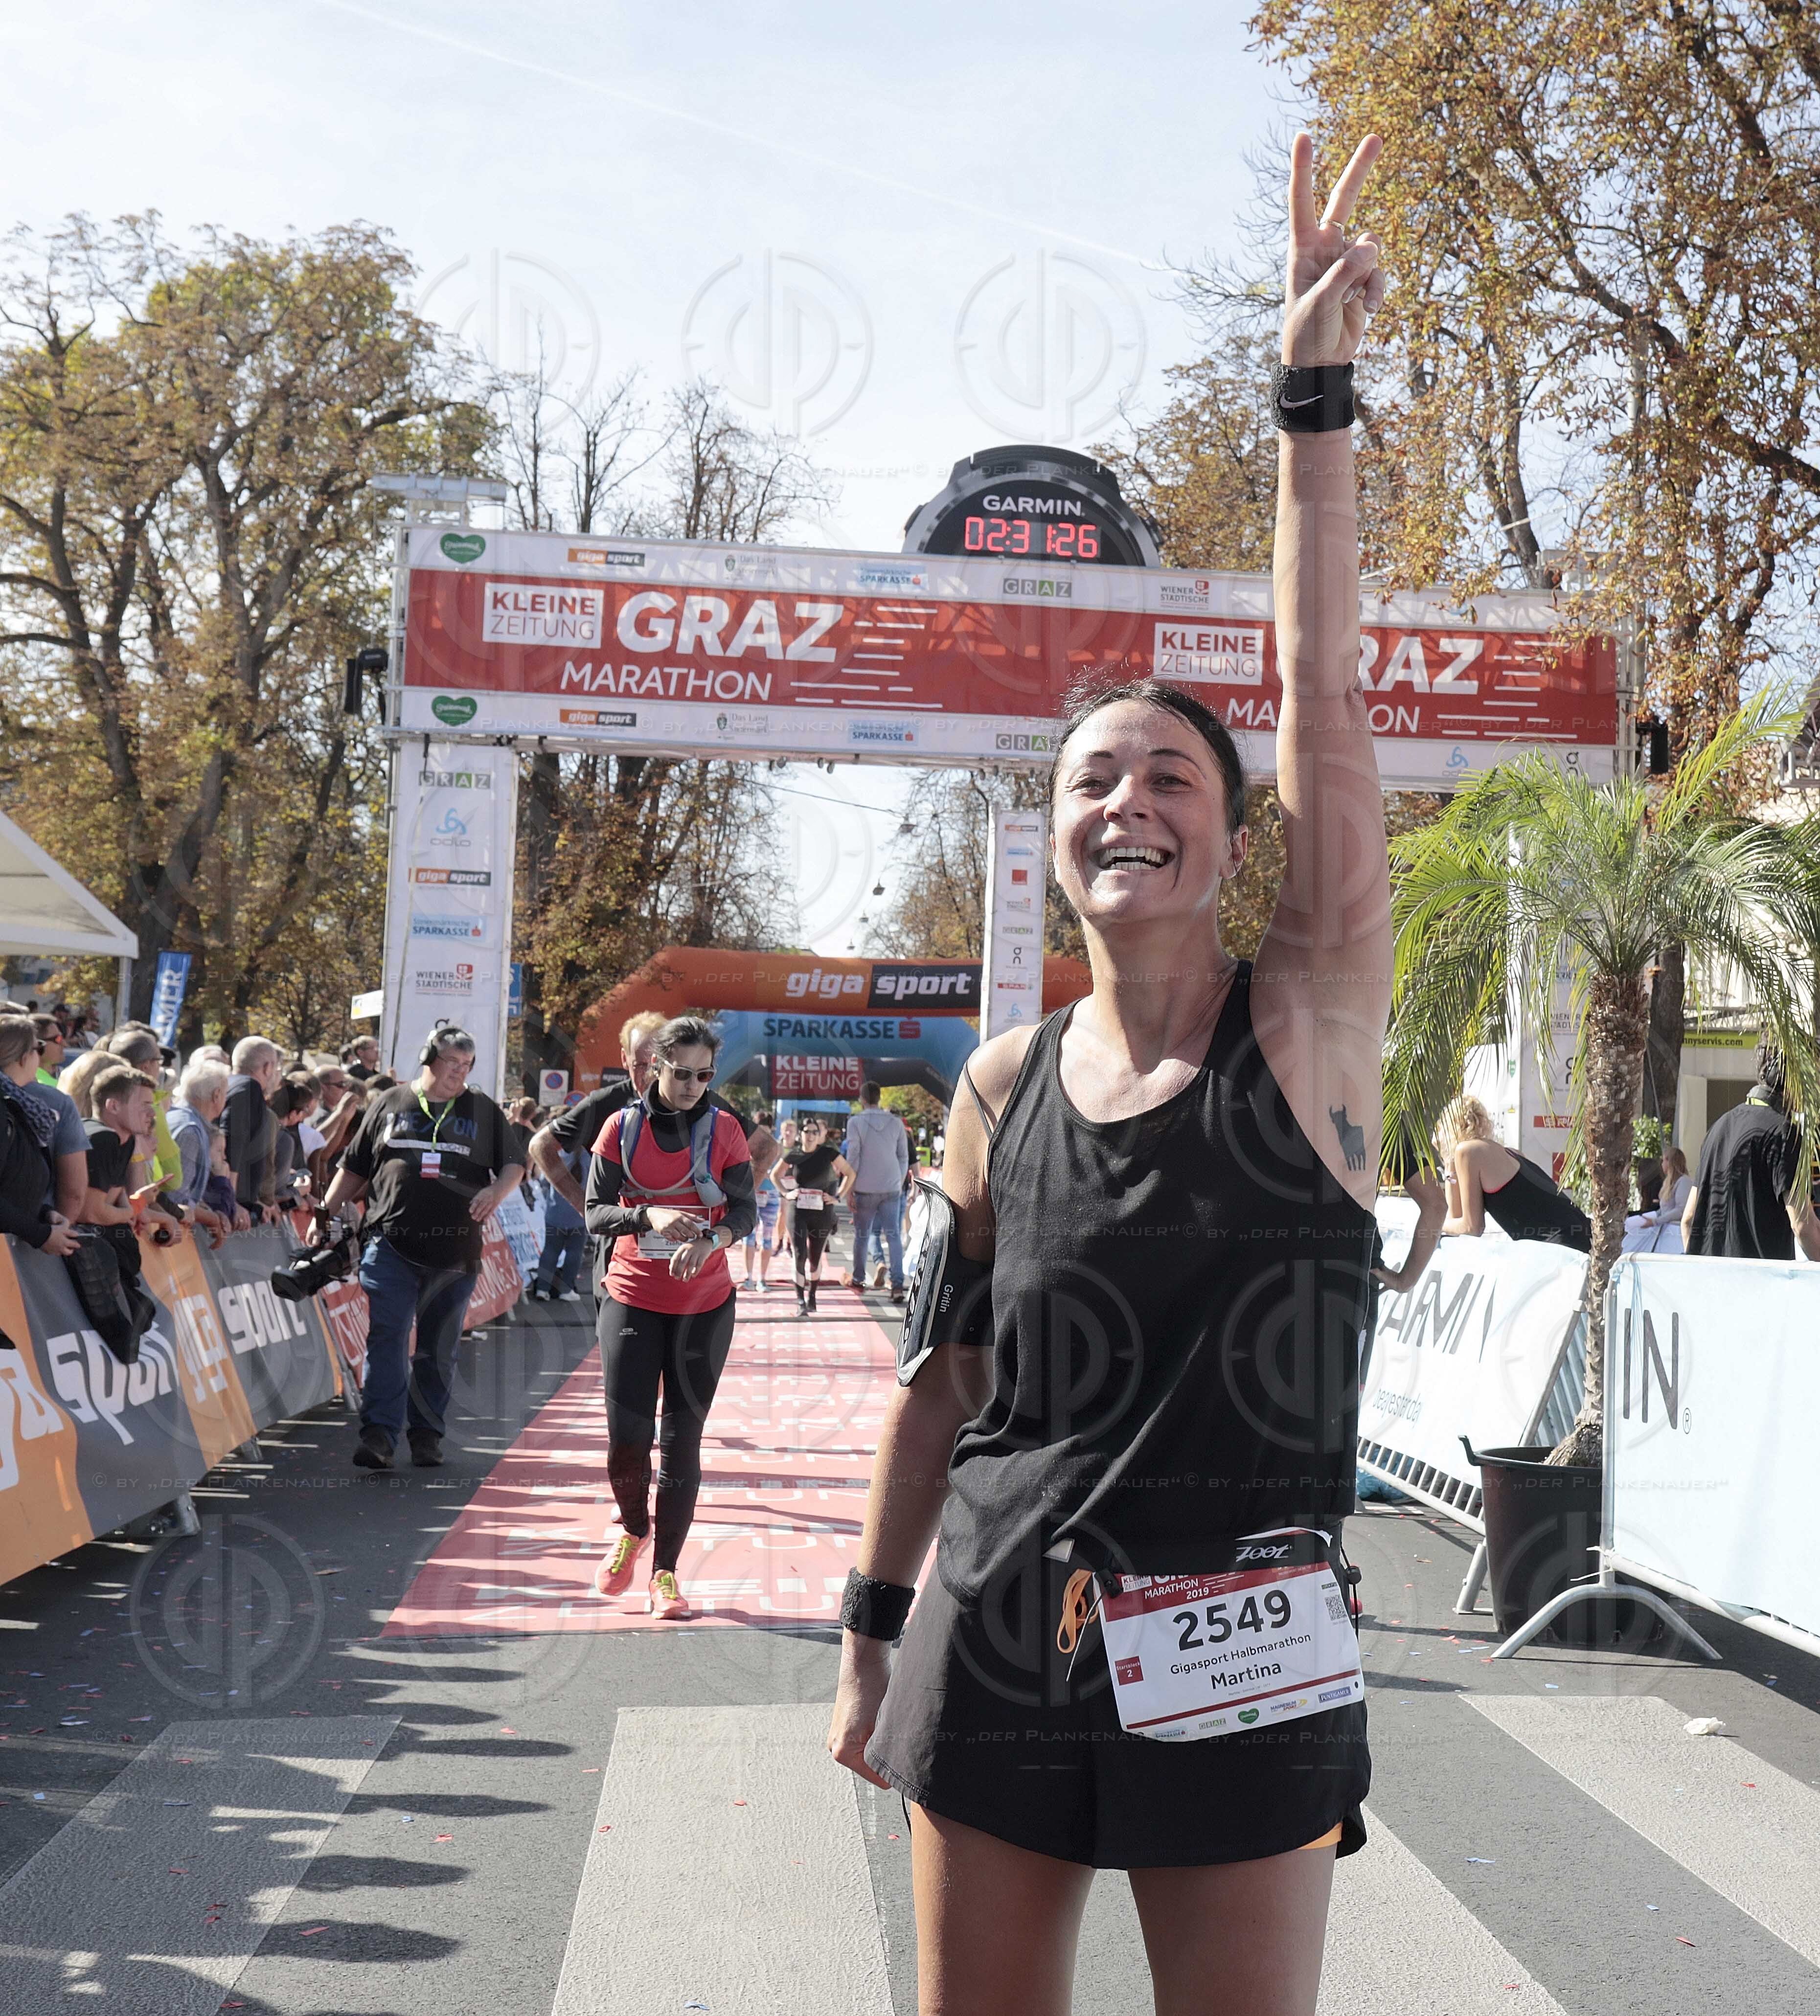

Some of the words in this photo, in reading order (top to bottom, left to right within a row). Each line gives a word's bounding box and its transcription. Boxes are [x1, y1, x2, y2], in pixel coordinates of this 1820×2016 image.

[983, 495, 1082, 516] GARMIN
[860, 575, 911, 585] SPARKASSE
[1004, 578, 1071, 597] GRAZ
[1160, 586, 1194, 595] WIENER
[491, 591, 596, 617] KLEINE
[491, 614, 595, 640] ZEITUNG
[616, 591, 843, 663] GRAZ
[1161, 631, 1257, 655] KLEINE
[1160, 653, 1256, 677] ZEITUNG
[1276, 634, 1484, 696] RAZ
[560, 661, 772, 702] MARATHON
[568, 711, 595, 724] giga
[598, 714, 632, 726] sport
[1226, 698, 1420, 733] MAON
[853, 731, 904, 742] SPARKASSE
[997, 734, 1047, 751] GRA
[420, 772, 488, 789] GRAZ
[418, 870, 447, 882] giga
[450, 873, 487, 884] sport
[412, 926, 470, 937] SPARKASSE
[416, 970, 454, 979] WIENER
[785, 968, 864, 999] giga
[875, 971, 972, 1000] sport
[763, 1018, 895, 1040] SPARKASSE
[775, 1055, 859, 1071] KLEINE
[775, 1072, 860, 1091] ZEITUNG
[939, 1284, 954, 1313] Gritin
[1124, 1579, 1150, 1590] ZEITUNG
[1145, 1578, 1198, 1599] MARATHON
[1186, 1586, 1209, 1600] 2019
[1173, 1589, 1291, 1651] 2549
[1170, 1653, 1228, 1676] Gigasport
[1230, 1633, 1311, 1661] Halbmarathon
[1127, 1669, 1133, 1677] 2
[1211, 1663, 1282, 1690] Martina
